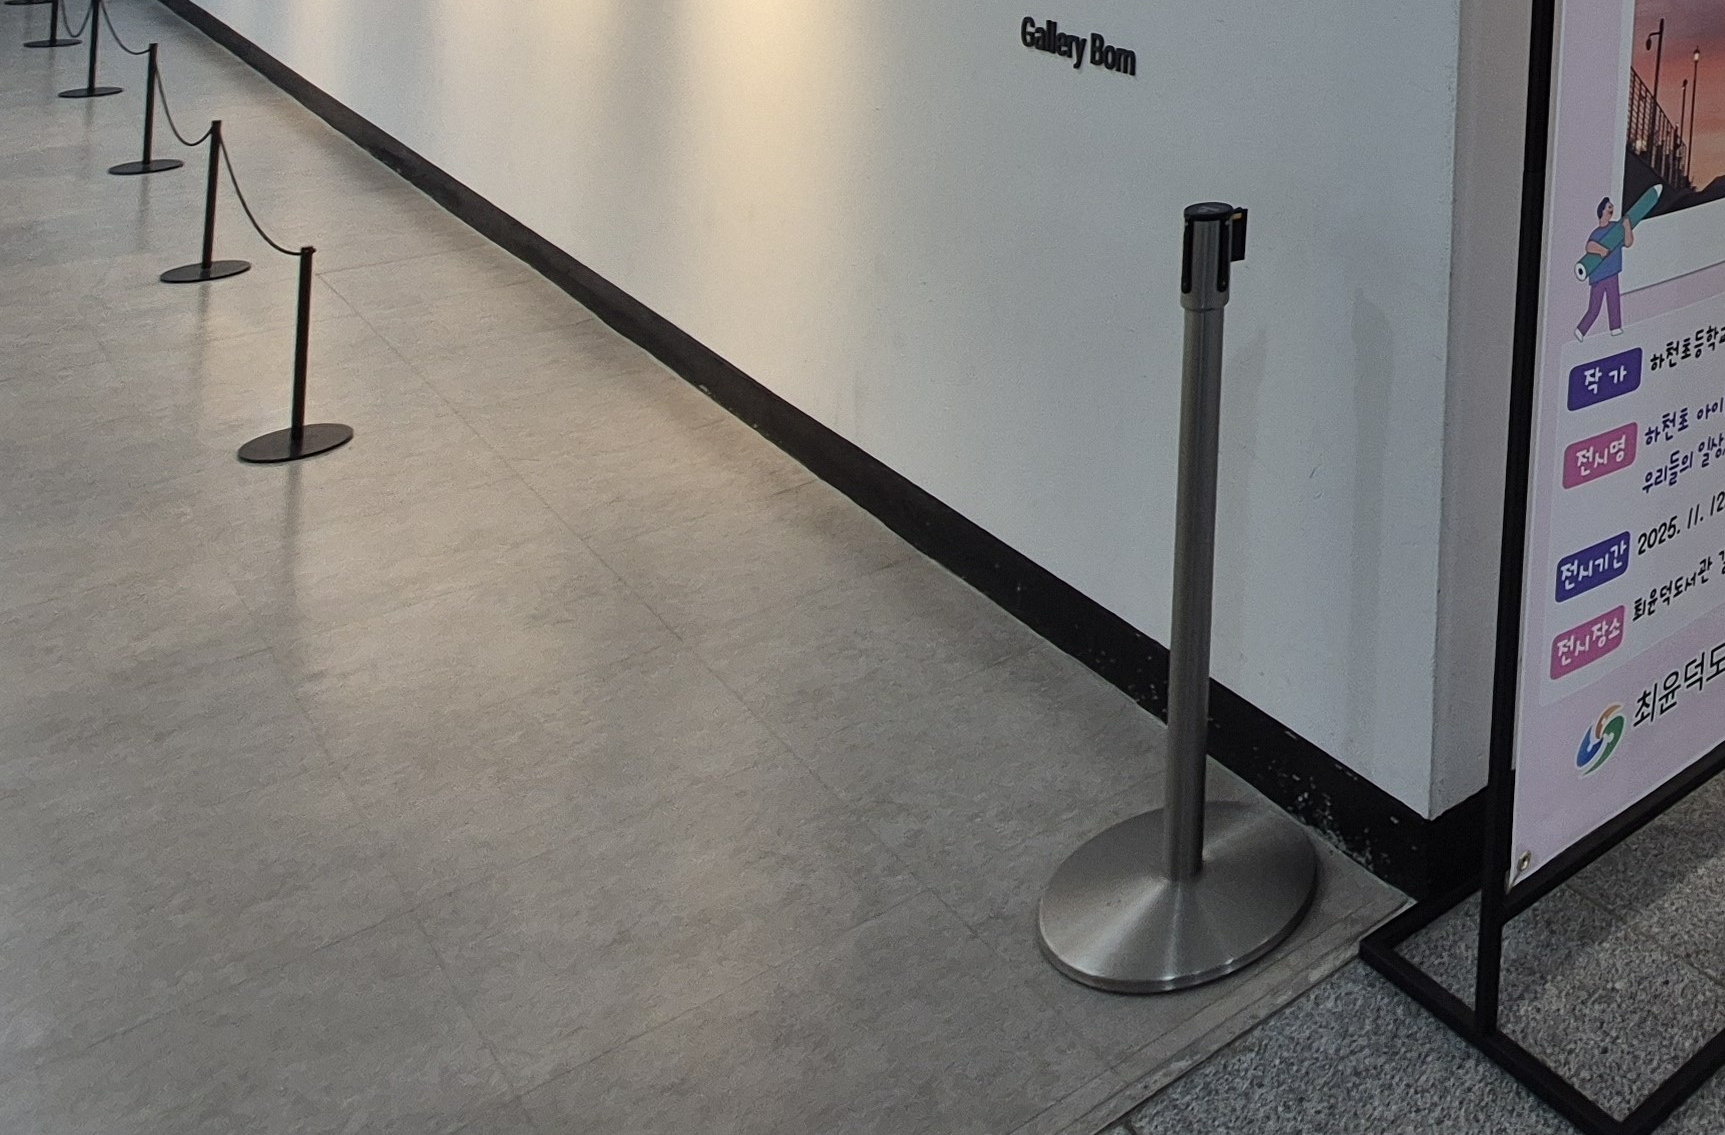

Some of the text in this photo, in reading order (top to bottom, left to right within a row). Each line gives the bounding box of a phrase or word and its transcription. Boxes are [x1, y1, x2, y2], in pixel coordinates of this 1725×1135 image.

[1020, 16, 1137, 76] Gallery Bom
[1644, 407, 1689, 446] 하천초
[1575, 435, 1627, 477] 전시명
[1641, 450, 1694, 494] 우리들의
[1637, 515, 1681, 556] 2025.
[1686, 503, 1704, 530] 11.
[1559, 539, 1629, 590] 전시기간
[1632, 557, 1714, 622] 최윤덕도서관
[1556, 615, 1624, 667] 전시장소
